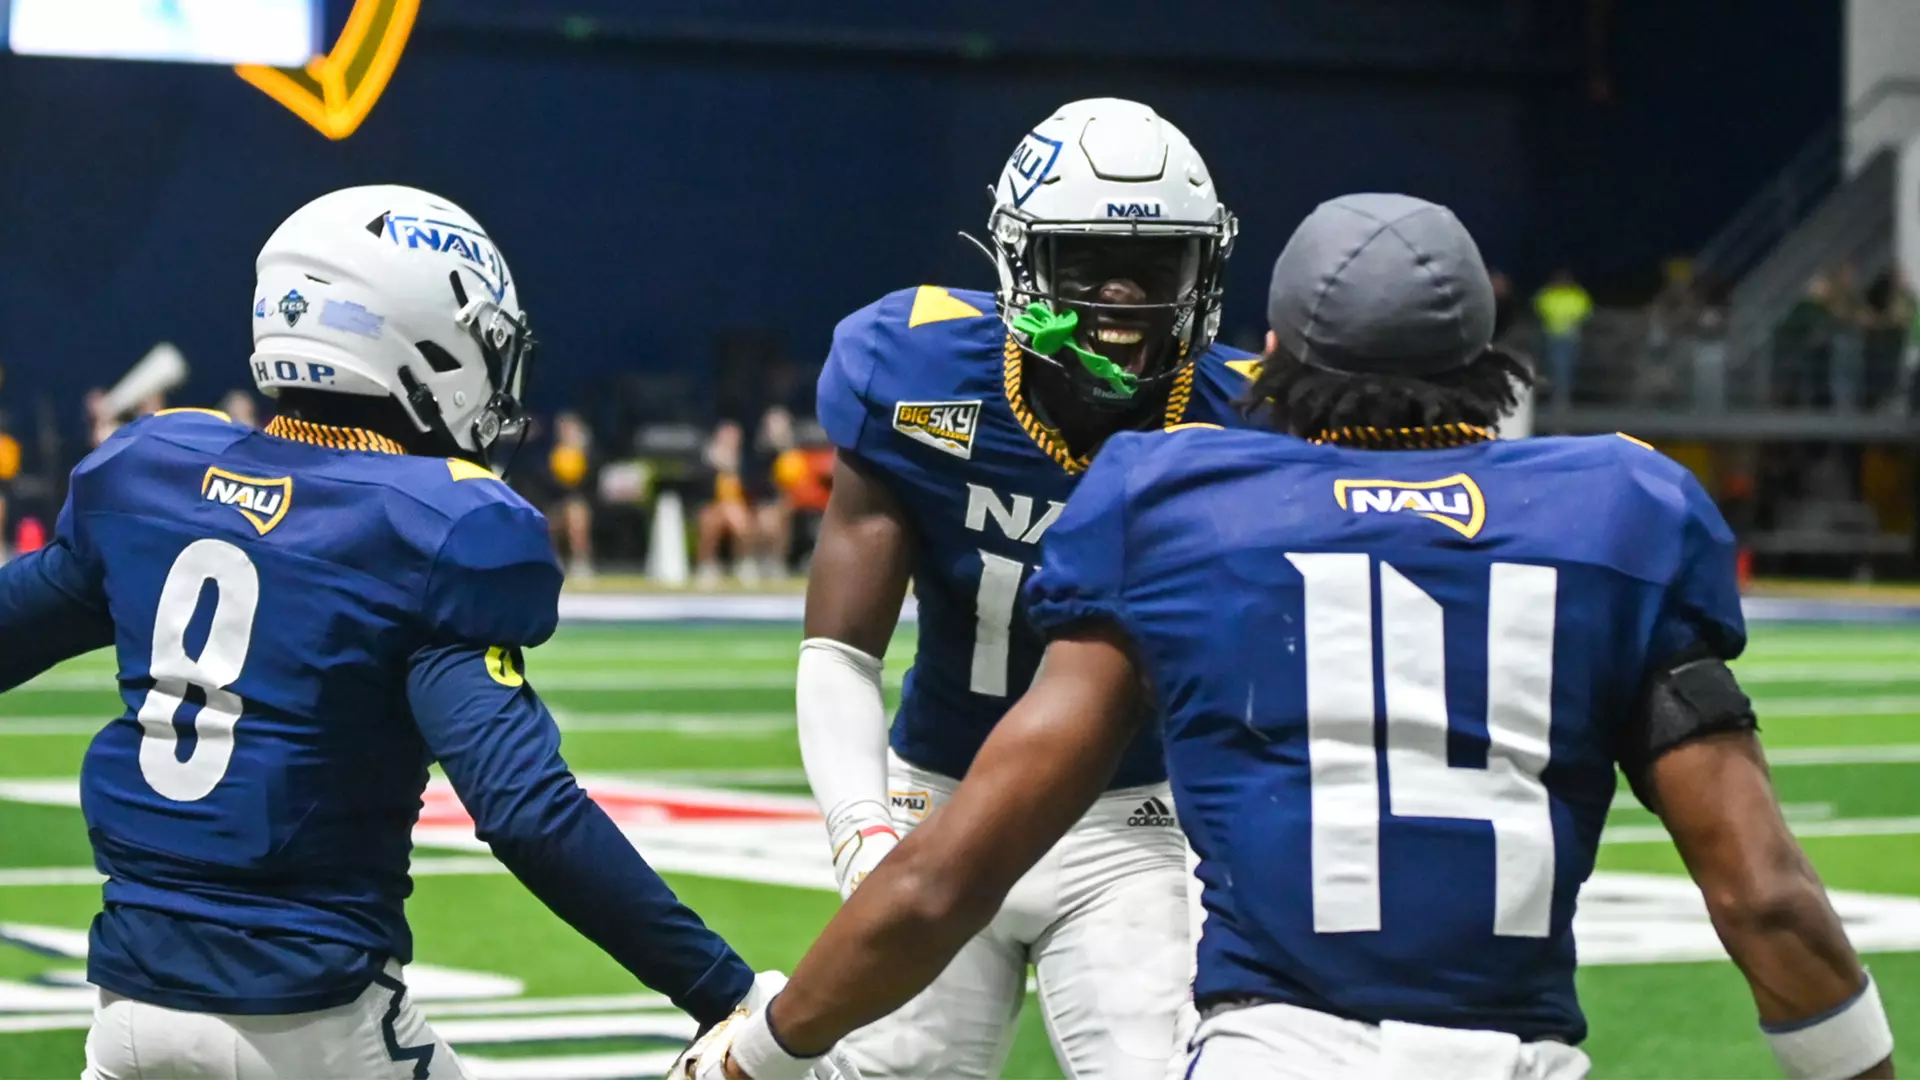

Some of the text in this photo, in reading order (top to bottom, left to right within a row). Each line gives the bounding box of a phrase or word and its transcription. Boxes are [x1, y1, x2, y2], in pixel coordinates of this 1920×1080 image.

[1011, 141, 1043, 181] AU
[1107, 203, 1161, 218] NAU
[404, 225, 496, 275] NAU
[207, 479, 281, 516] NAU
[1351, 489, 1471, 516] NAU
[969, 547, 1043, 698] 1
[137, 538, 260, 803] 8
[1283, 552, 1558, 938] 14
[891, 796, 926, 811] NAU
[1127, 814, 1175, 828] adidas
